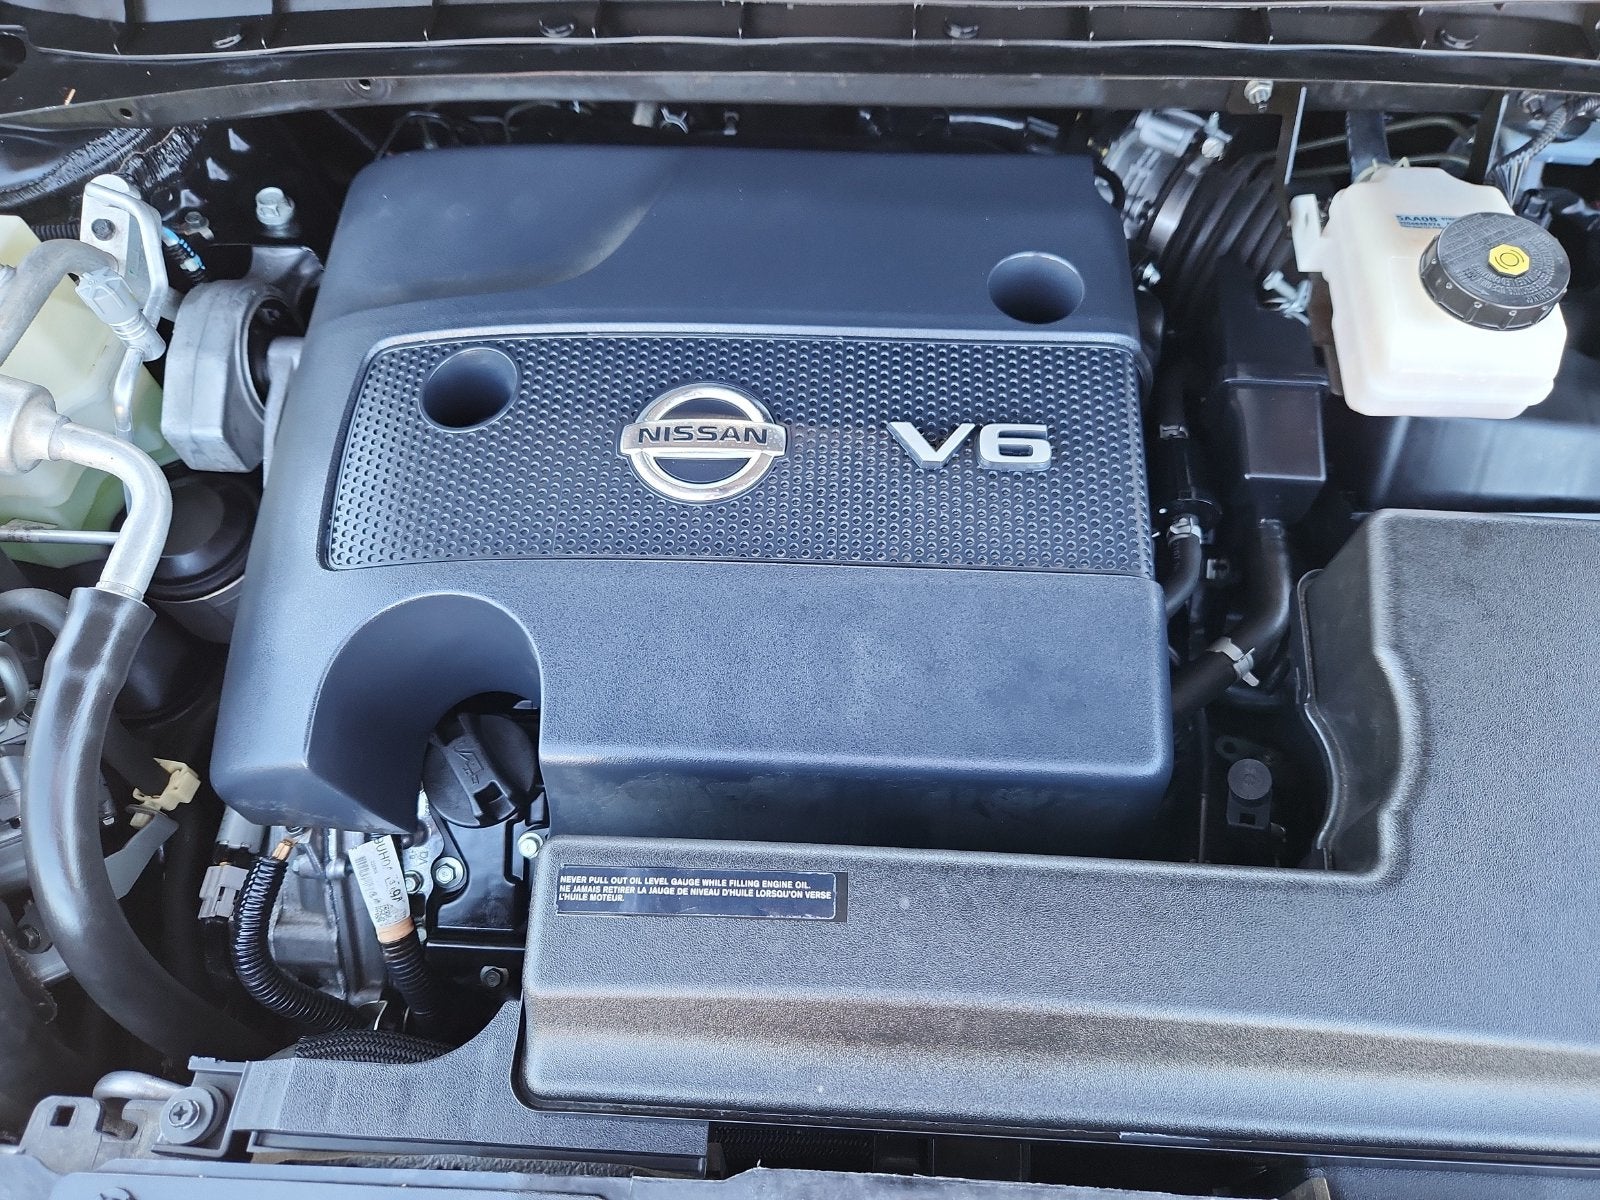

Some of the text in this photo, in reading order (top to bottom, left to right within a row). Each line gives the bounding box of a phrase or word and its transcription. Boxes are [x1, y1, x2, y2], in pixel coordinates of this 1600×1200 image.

[638, 425, 768, 446] NISSAN
[886, 421, 1052, 472] V6
[560, 875, 811, 889] NEVER PULL OUT OIL LEVEL GAUGE WHILE FILLING ENGINE OIL.
[558, 892, 625, 902] L'HUILE MOTEUR.
[559, 884, 832, 900] NE JAMAIS RETIRER LA JAUGE DE NIVEAU D'HUILE LORSQU'ON VERSE
